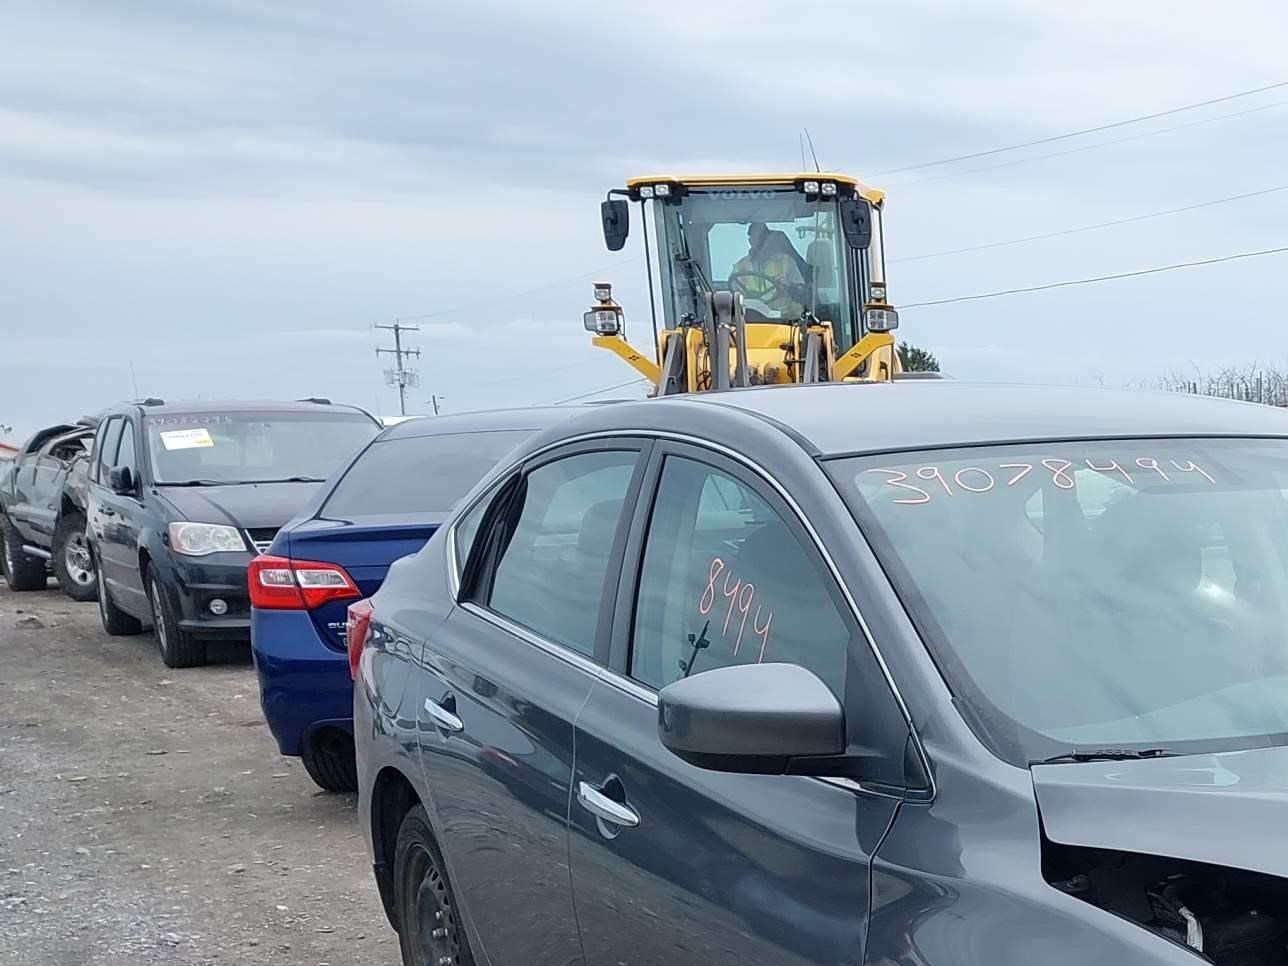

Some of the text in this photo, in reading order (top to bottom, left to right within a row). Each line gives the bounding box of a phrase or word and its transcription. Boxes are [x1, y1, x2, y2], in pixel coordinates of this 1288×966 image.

[707, 188, 777, 200] VOLVO
[866, 457, 1216, 505] 39078494
[699, 557, 773, 665] 8494
